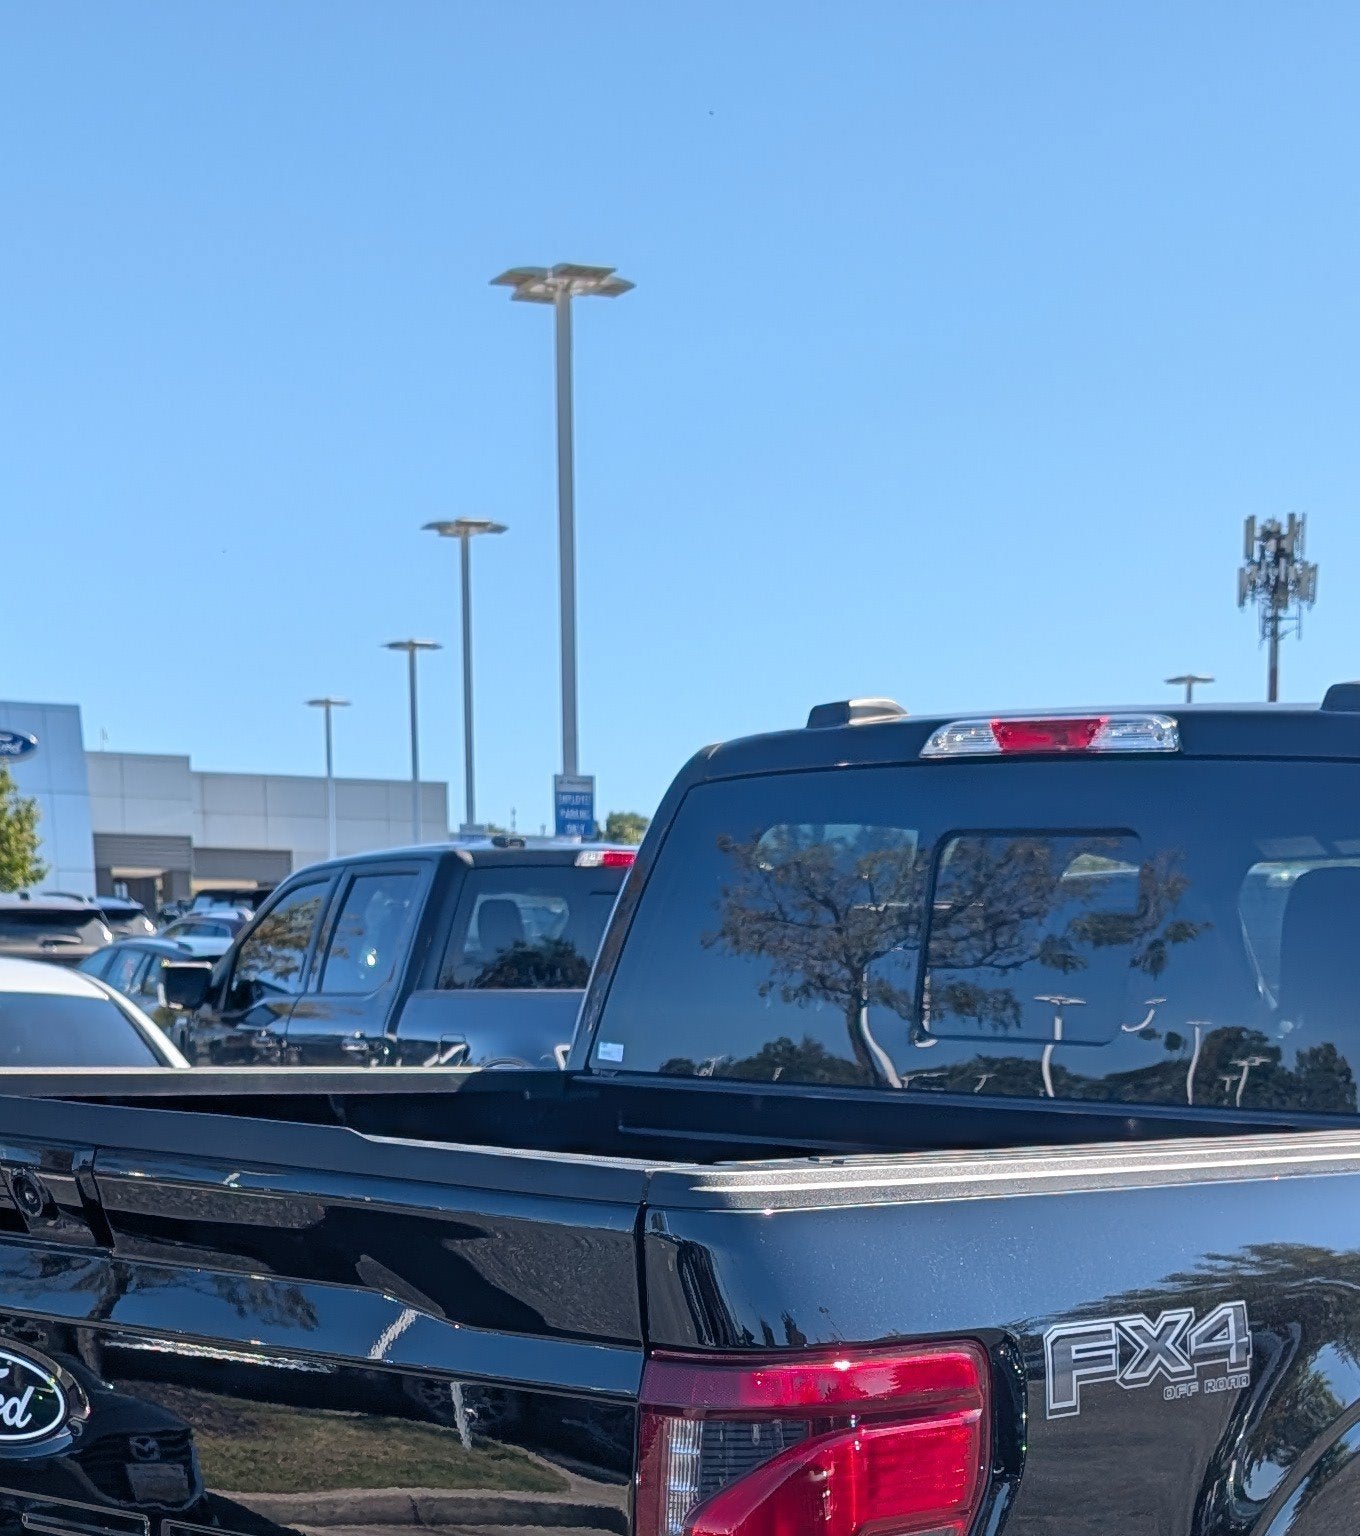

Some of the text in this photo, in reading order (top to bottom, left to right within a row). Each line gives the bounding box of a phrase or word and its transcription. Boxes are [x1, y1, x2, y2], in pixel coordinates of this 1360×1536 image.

[1043, 1300, 1253, 1420] FX4
[1163, 1373, 1250, 1401] OFF ROAD
